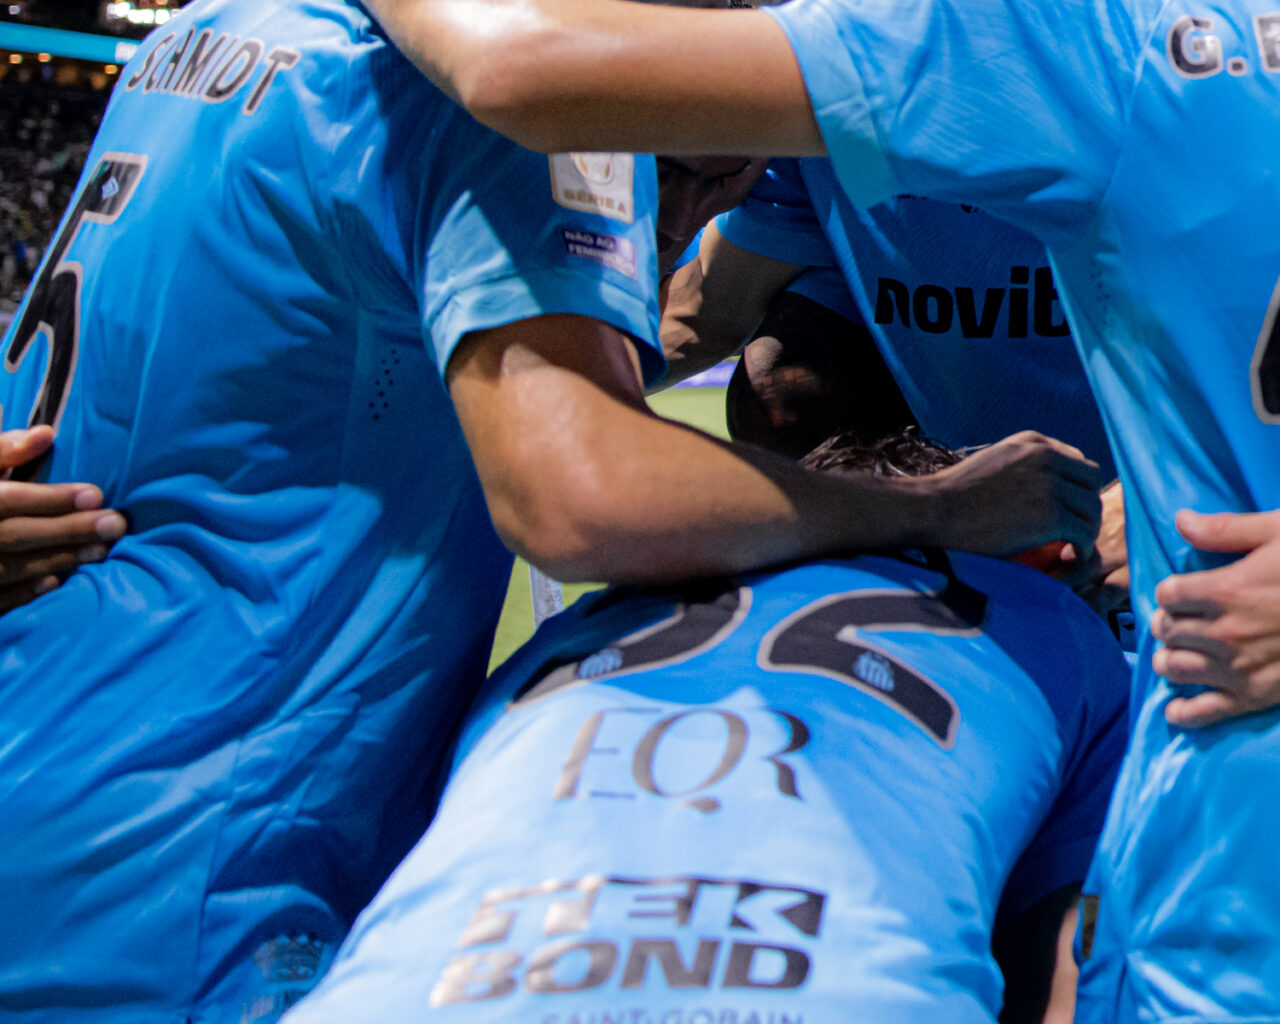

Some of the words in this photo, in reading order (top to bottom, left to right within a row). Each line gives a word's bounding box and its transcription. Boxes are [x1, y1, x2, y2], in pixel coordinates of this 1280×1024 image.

[125, 25, 301, 116] SCHMIDT
[459, 874, 828, 948] TEK
[429, 936, 812, 1008] BOND
